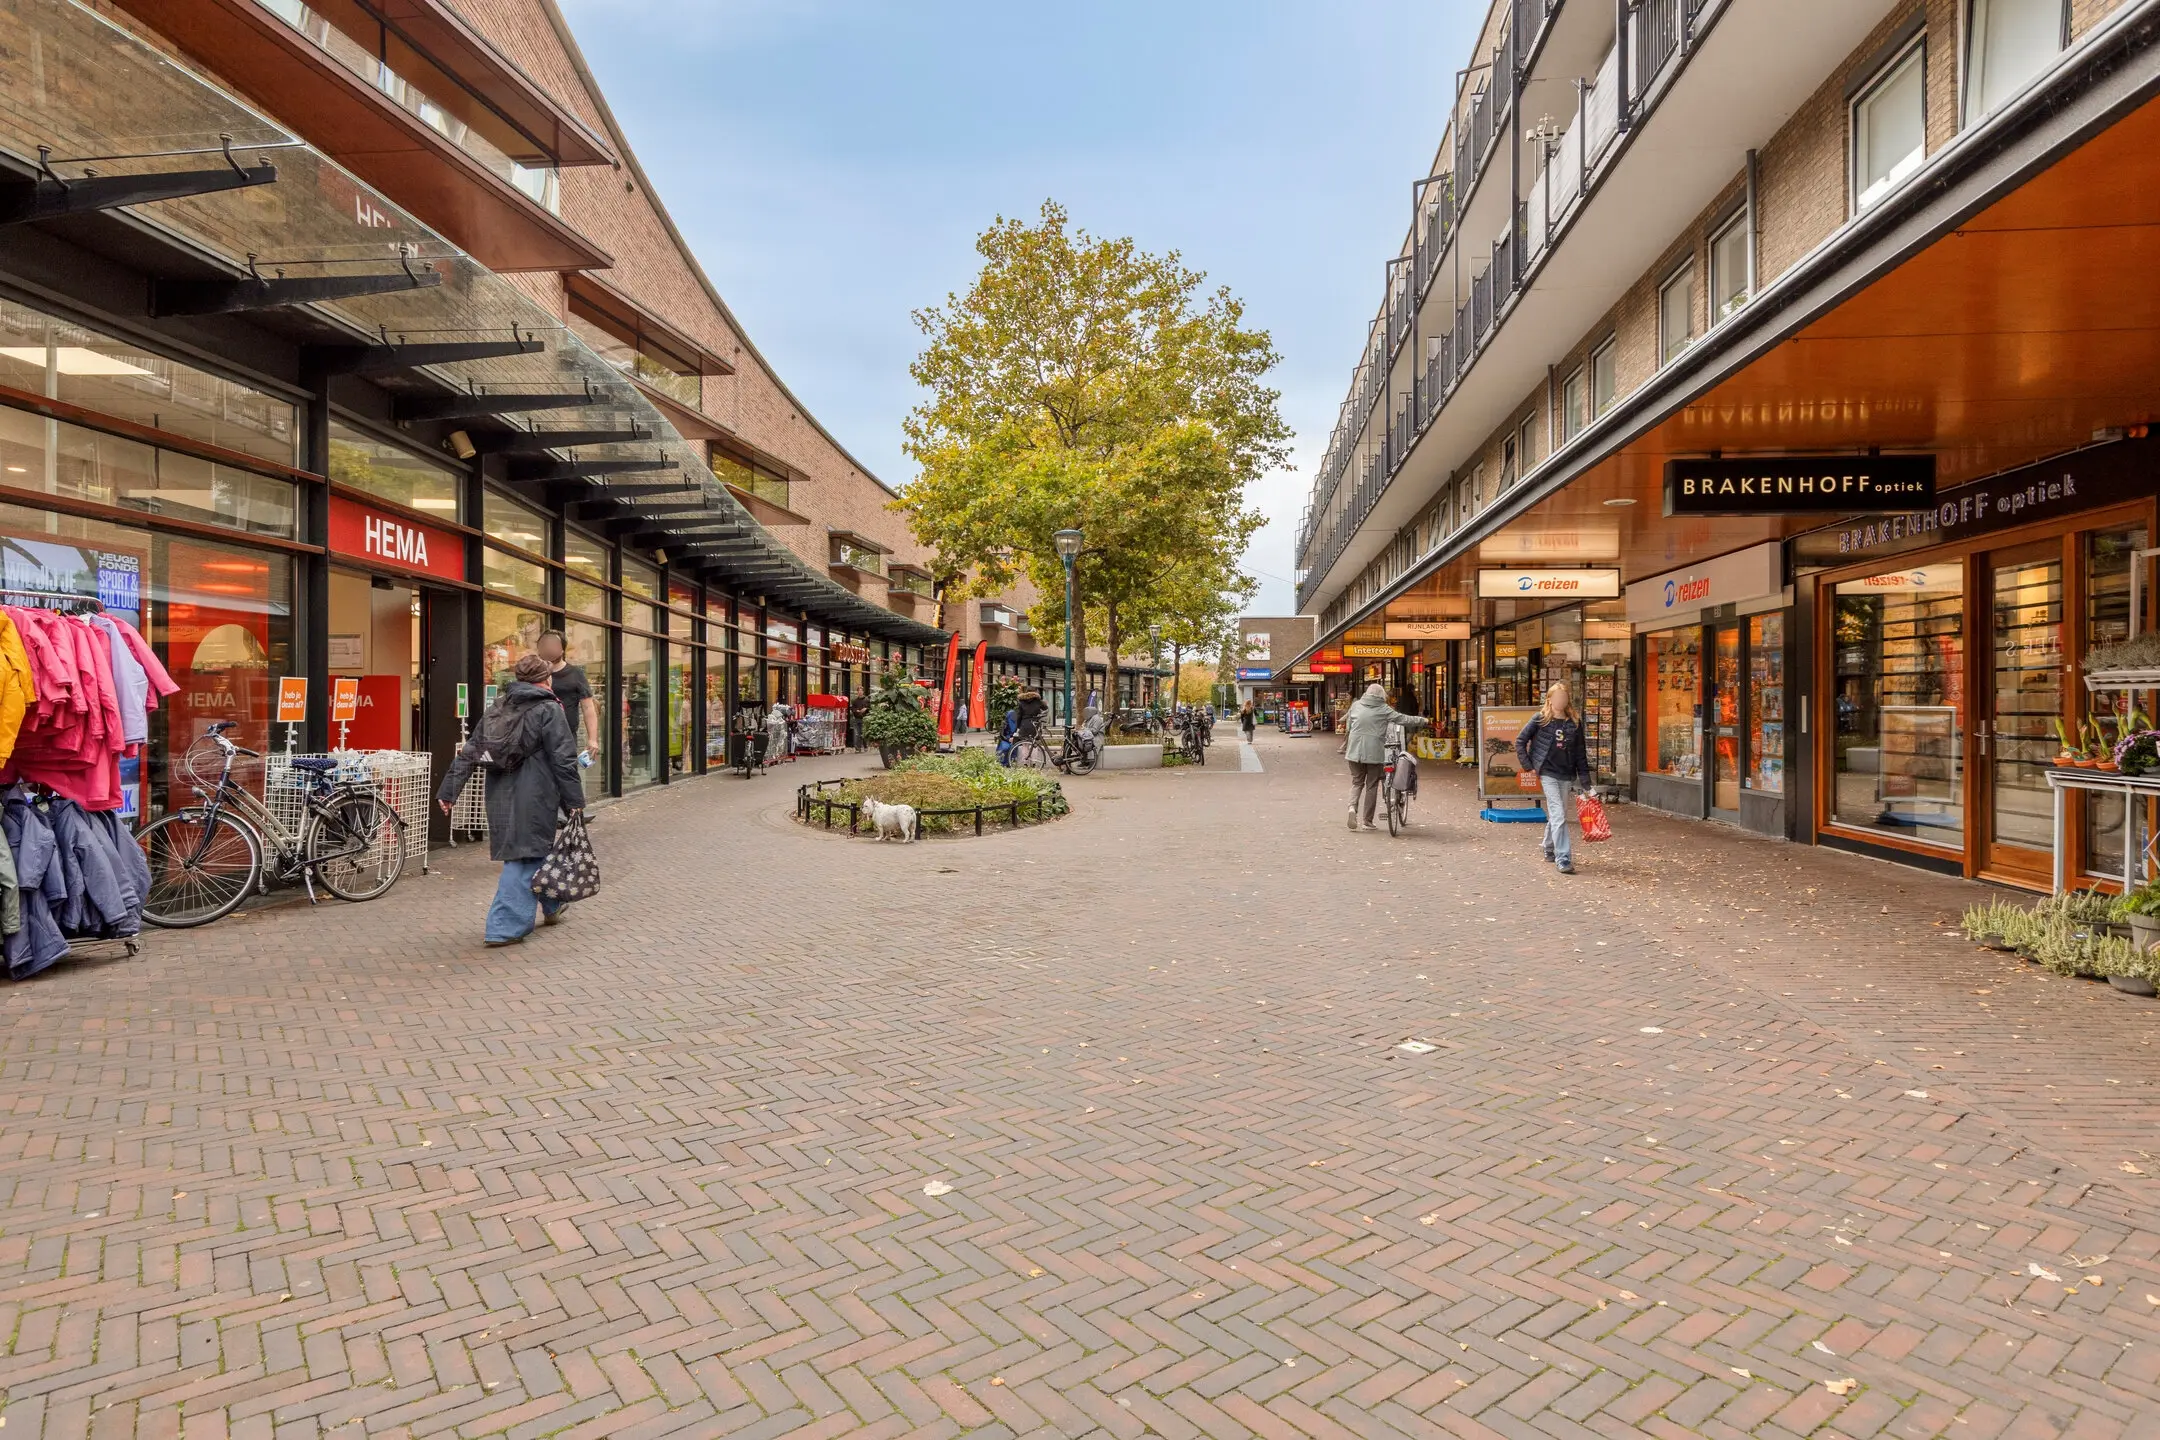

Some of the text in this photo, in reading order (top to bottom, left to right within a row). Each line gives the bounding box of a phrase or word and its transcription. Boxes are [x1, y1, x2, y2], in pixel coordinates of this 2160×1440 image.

[1683, 475, 1924, 495] BRAKENHOFF optiek
[1838, 474, 2077, 553] BRAKENHOFF optiek
[365, 515, 429, 567] HEMA
[98, 552, 139, 565] JEUGD
[98, 560, 140, 573] FONDS
[99, 570, 139, 593] SPORT &
[1518, 576, 1579, 590] D-reizen
[99, 588, 140, 610] CULTUUR
[1664, 577, 1710, 608] D-reizen
[1353, 646, 1393, 655] Intertoys
